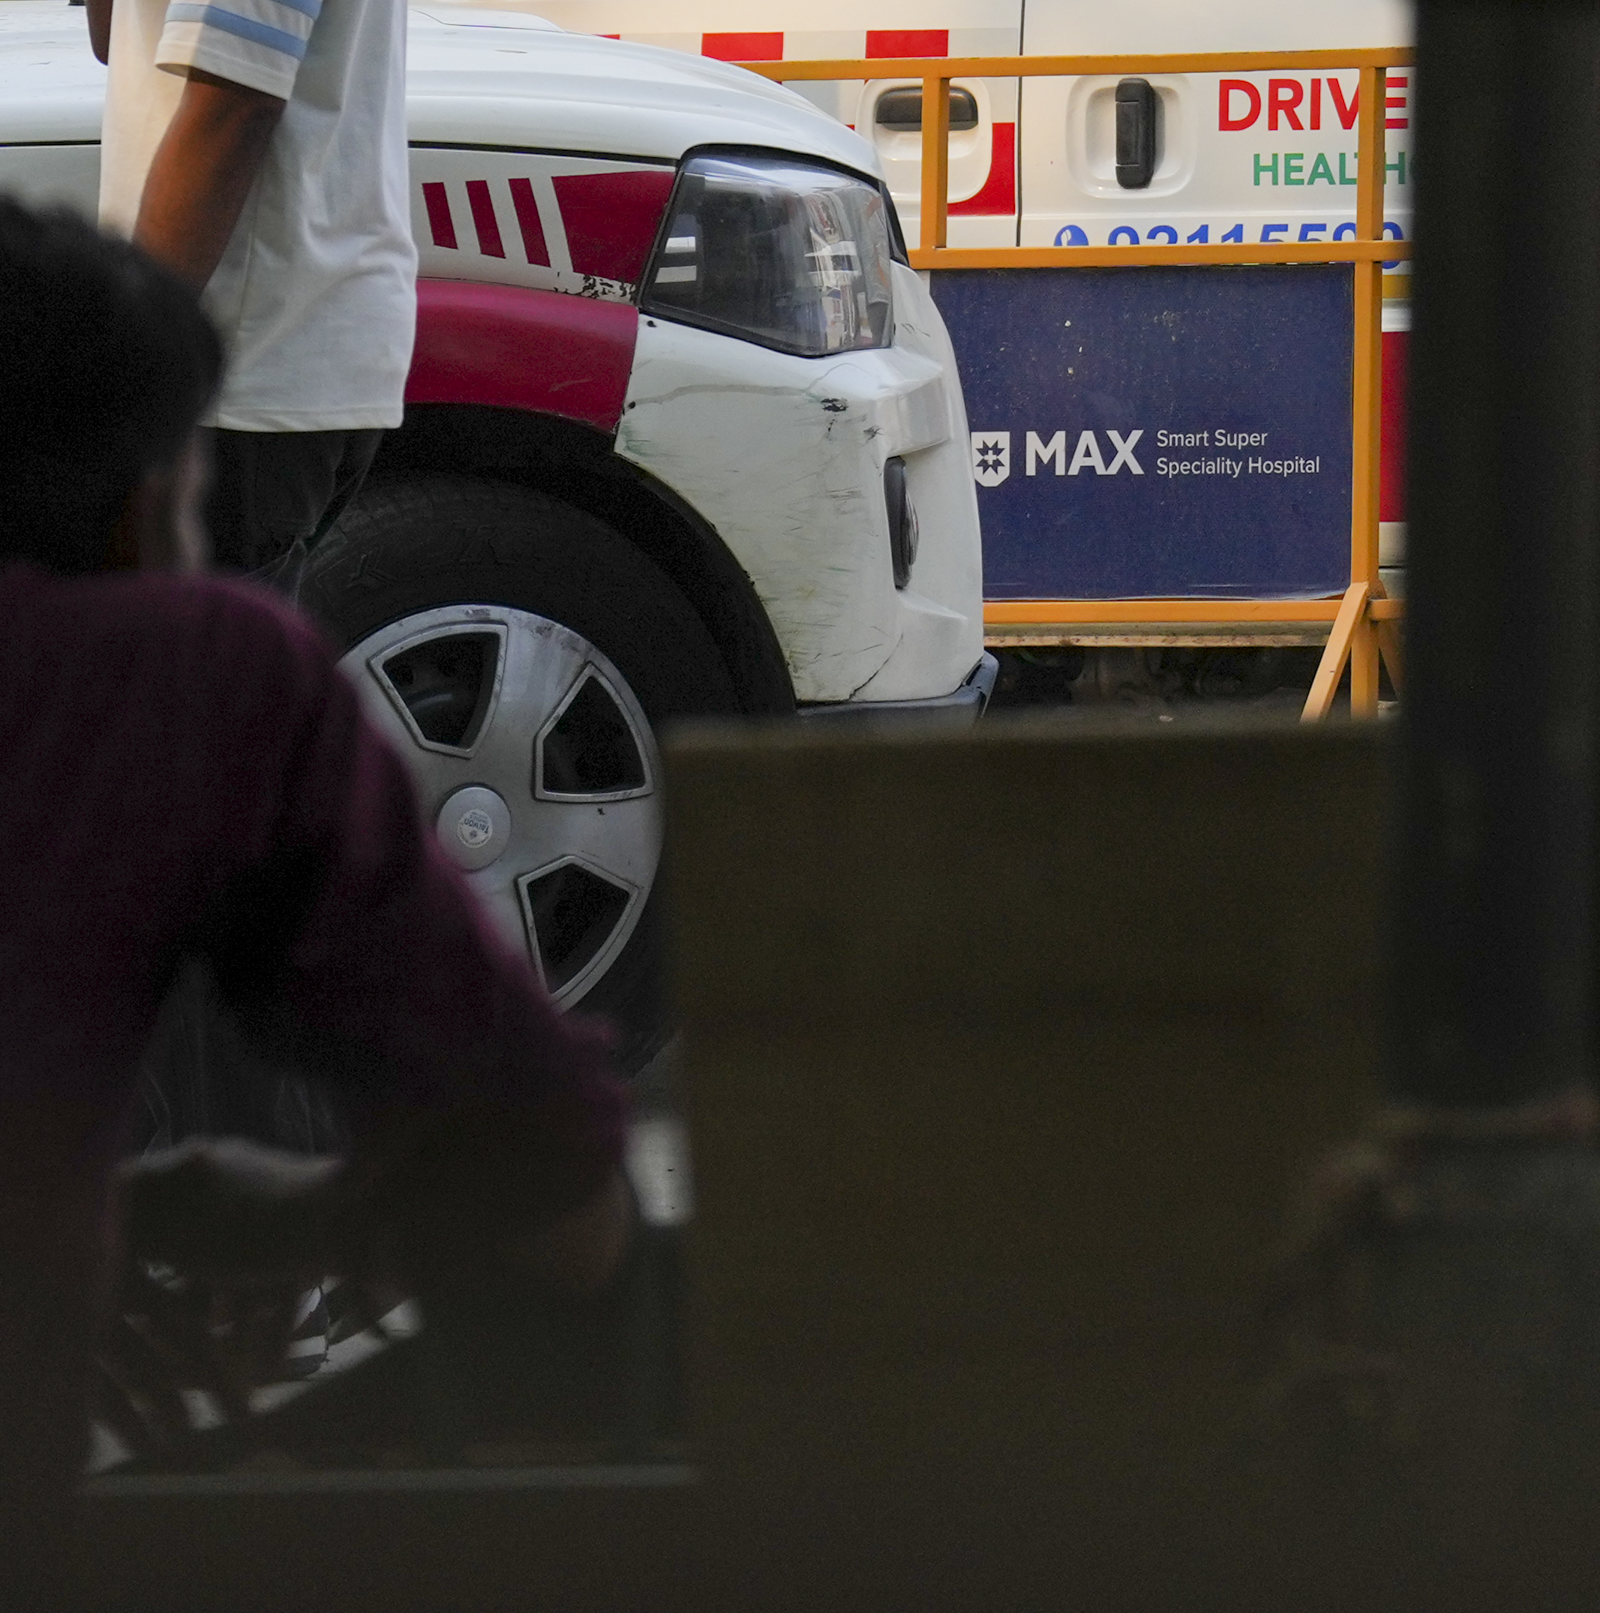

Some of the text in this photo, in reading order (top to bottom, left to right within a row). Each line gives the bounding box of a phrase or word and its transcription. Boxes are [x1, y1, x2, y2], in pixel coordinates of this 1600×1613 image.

[1253, 151, 1406, 186] HEALH
[1025, 429, 1145, 476] MAX
[1156, 429, 1268, 450] Smart Super
[1156, 455, 1320, 478] Speciality Hospital
